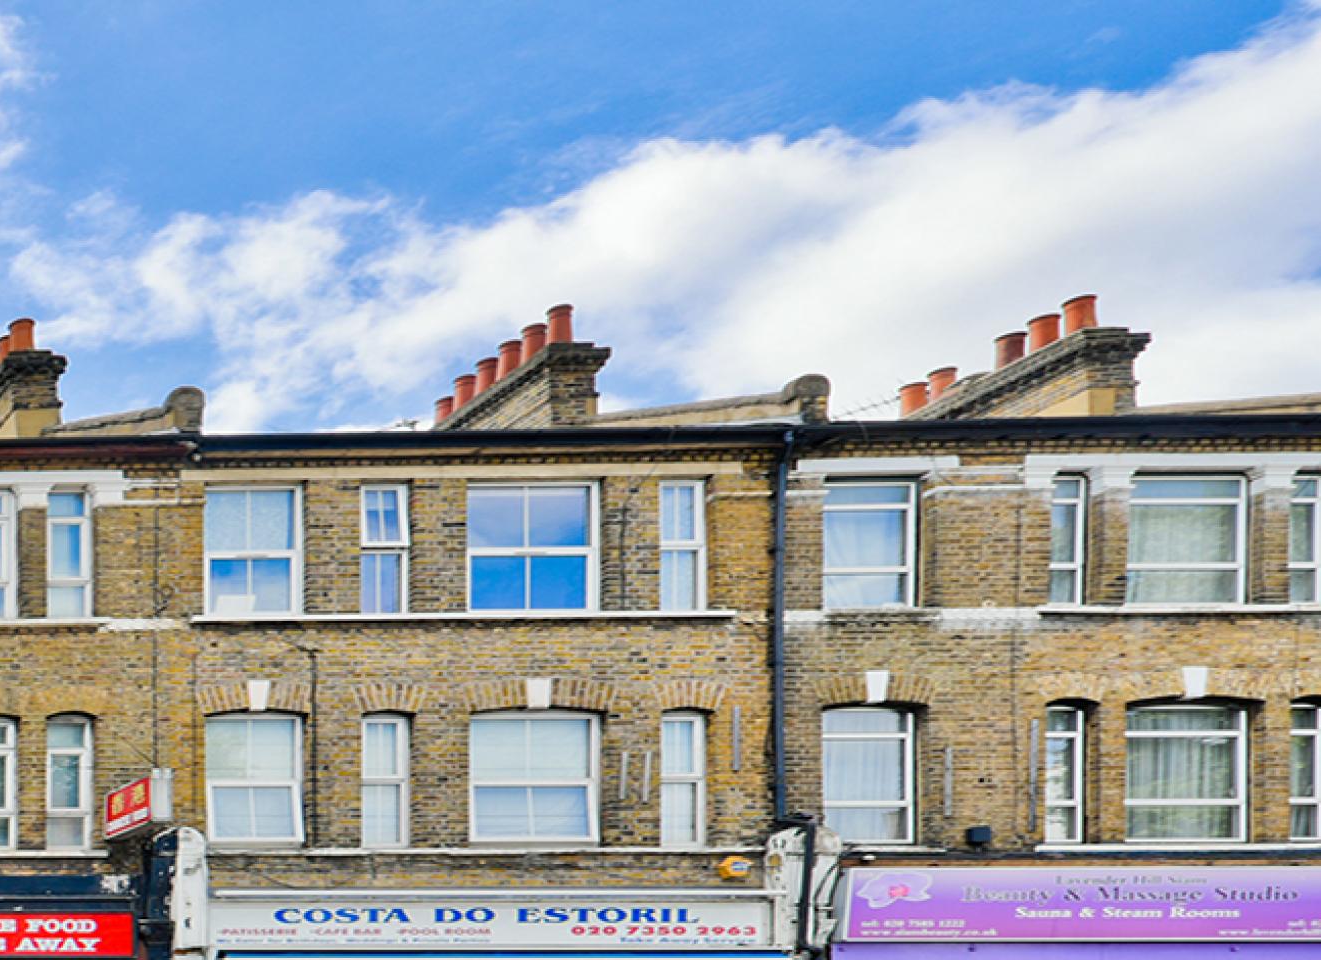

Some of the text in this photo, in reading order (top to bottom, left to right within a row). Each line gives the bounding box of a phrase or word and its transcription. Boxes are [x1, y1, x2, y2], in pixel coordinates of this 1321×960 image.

[960, 886, 1299, 905] Beauty & Massage Studio
[273, 907, 700, 924] COSTA DO ESTORIL
[1015, 906, 1241, 918] Sauna & Steam Rooms
[25, 918, 97, 933] FOOD
[570, 926, 757, 936] 020 7350 2963
[15, 937, 101, 951] AWAY
